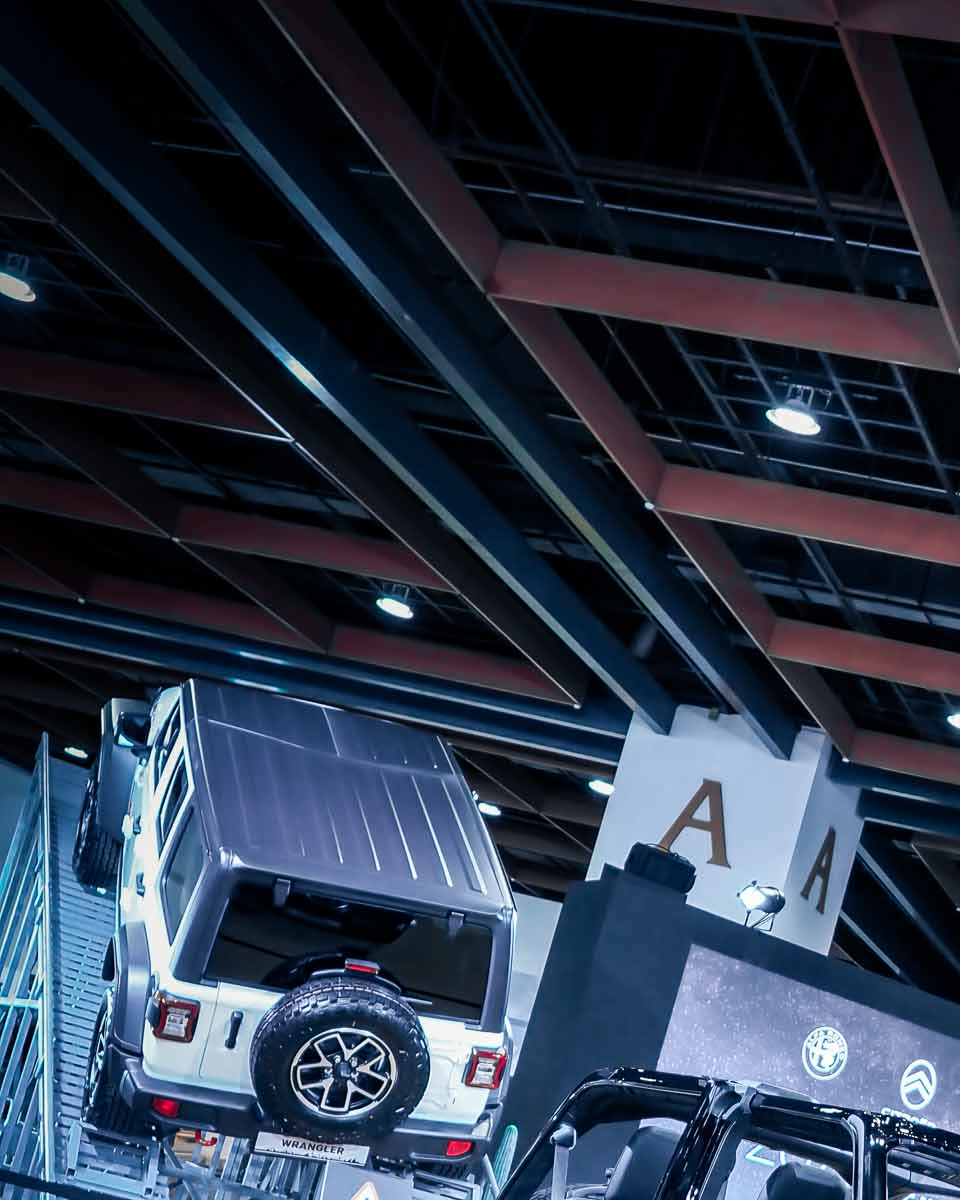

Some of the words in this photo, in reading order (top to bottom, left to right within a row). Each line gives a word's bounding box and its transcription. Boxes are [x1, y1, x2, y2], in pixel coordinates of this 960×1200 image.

[656, 778, 732, 870] A
[800, 825, 836, 915] A
[281, 1138, 345, 1155] WRANGLER
